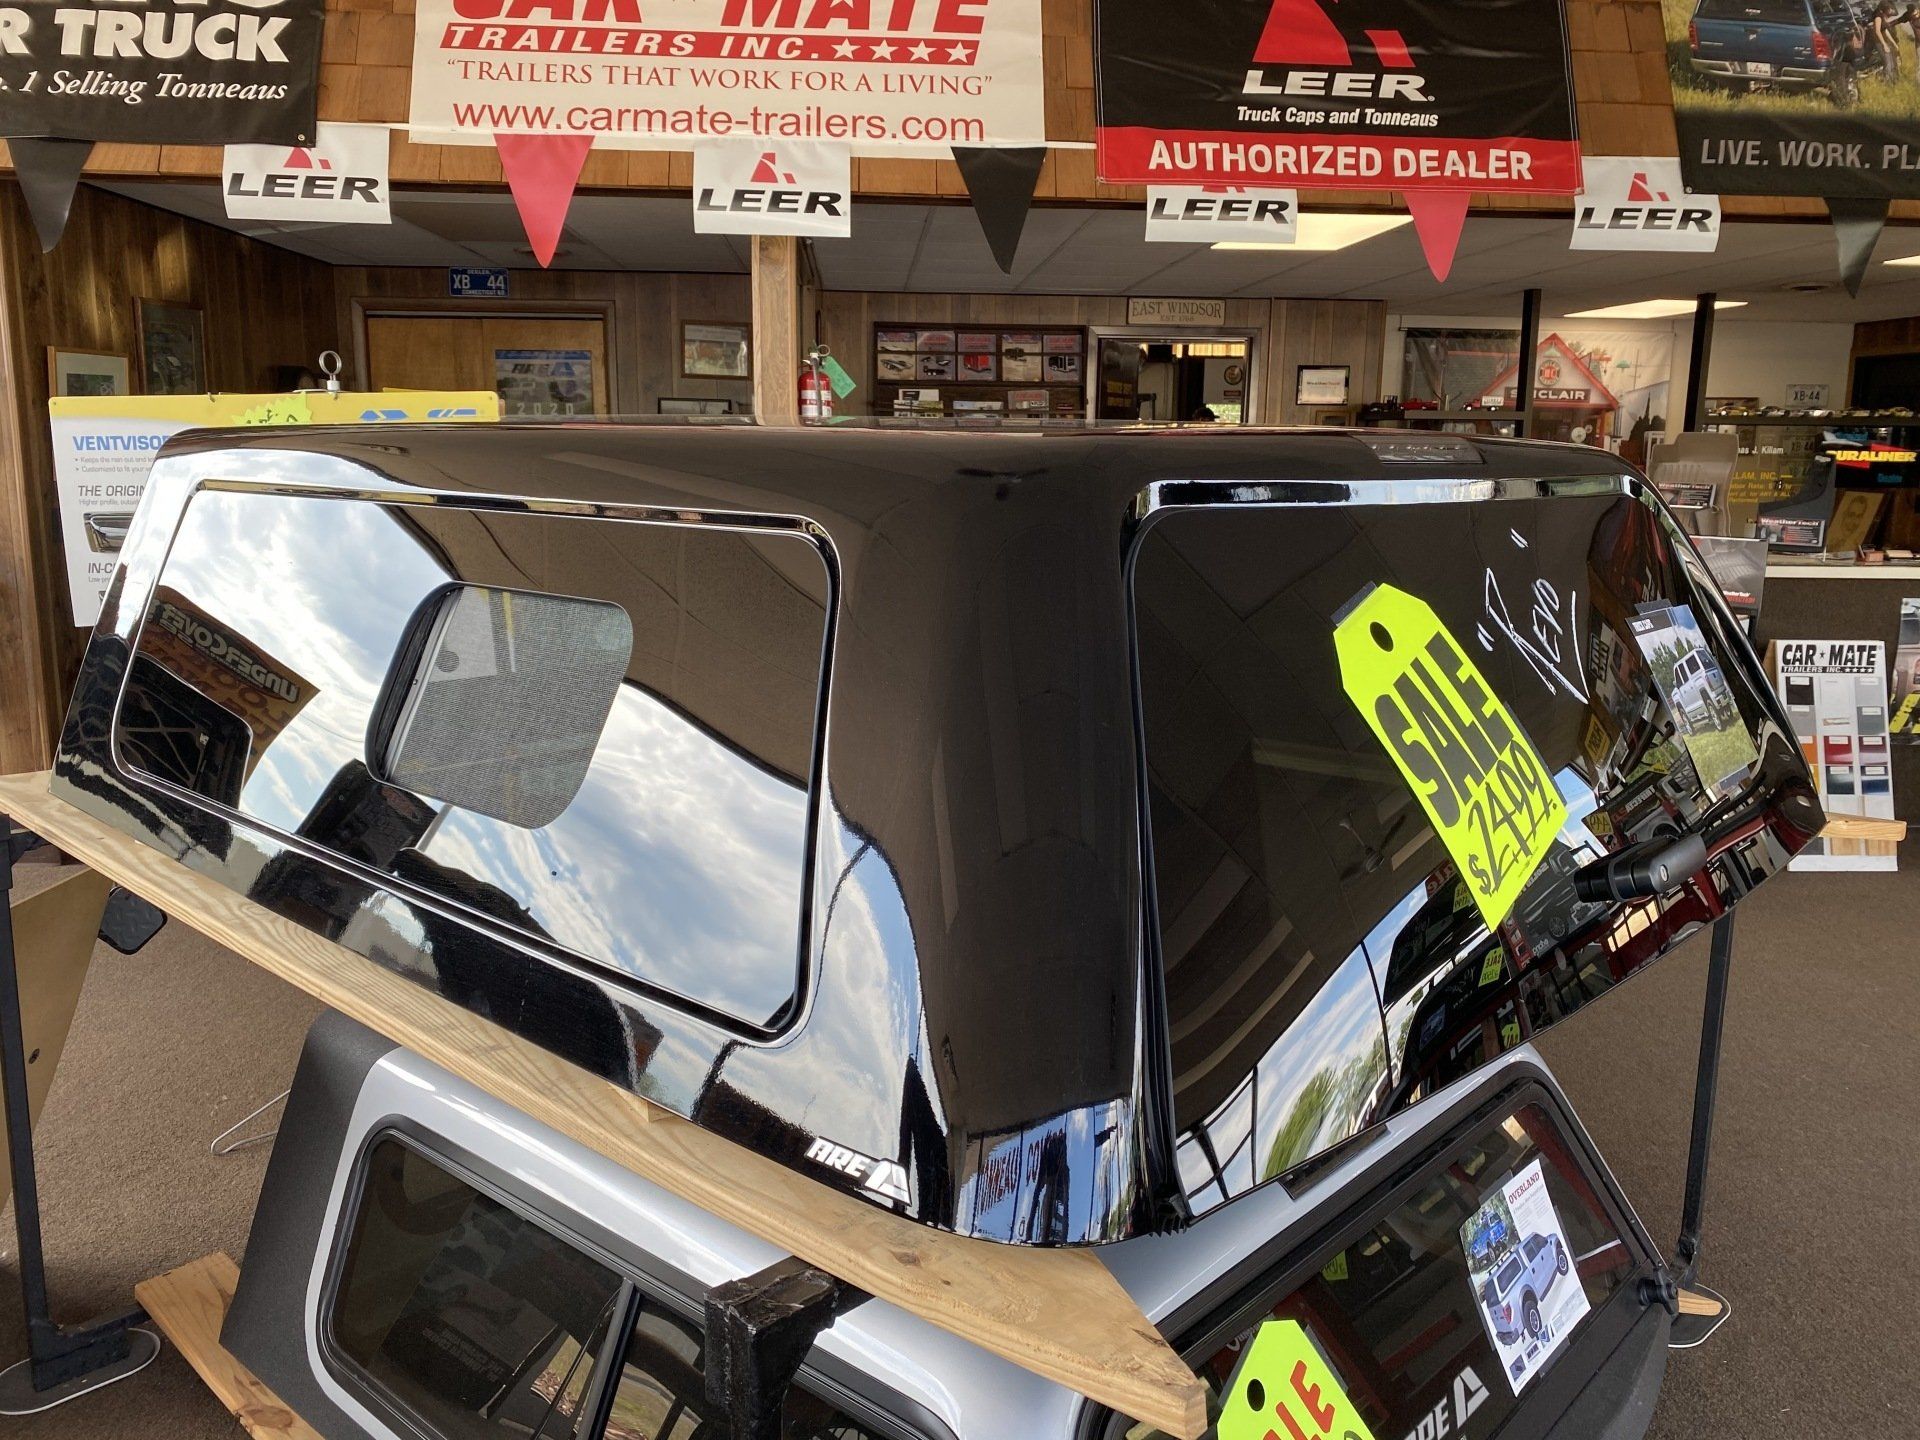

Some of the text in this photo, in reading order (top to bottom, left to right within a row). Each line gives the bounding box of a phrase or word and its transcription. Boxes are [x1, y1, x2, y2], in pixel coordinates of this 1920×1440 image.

[54, 8, 292, 63] TRUCK
[449, 25, 819, 59] TRAILERS INC.
[19, 70, 39, 93] 1
[47, 69, 148, 105] Selling
[155, 72, 288, 101] Tonneaus
[602, 64, 681, 87] THAT
[689, 68, 782, 89] WORK
[790, 70, 849, 92] FOR
[855, 72, 872, 93] A
[882, 73, 993, 96] LIVING”
[1242, 69, 1430, 102] LEER
[453, 102, 985, 142] www.carmate-trailers.com
[1236, 105, 1439, 128] Truck Caps and Tonneaus
[1148, 139, 1534, 181] AUTHORIZED DEALER
[1700, 138, 1769, 166] LIVE.
[1778, 140, 1871, 169] WORK.
[226, 171, 382, 204] LEER
[697, 187, 843, 218] LEER
[1149, 197, 1291, 225] LEER
[1576, 206, 1713, 233] LEER
[453, 274, 505, 290] XB 44
[1132, 301, 1221, 319] EAST WINDSOR
[516, 402, 574, 416] 2020
[1761, 445, 1784, 454] Killam
[78, 485, 102, 497] THE
[1782, 644, 1878, 666] CAR MATE
[1374, 630, 1515, 829] SALE
[1508, 1171, 1542, 1205] OVERLAND
